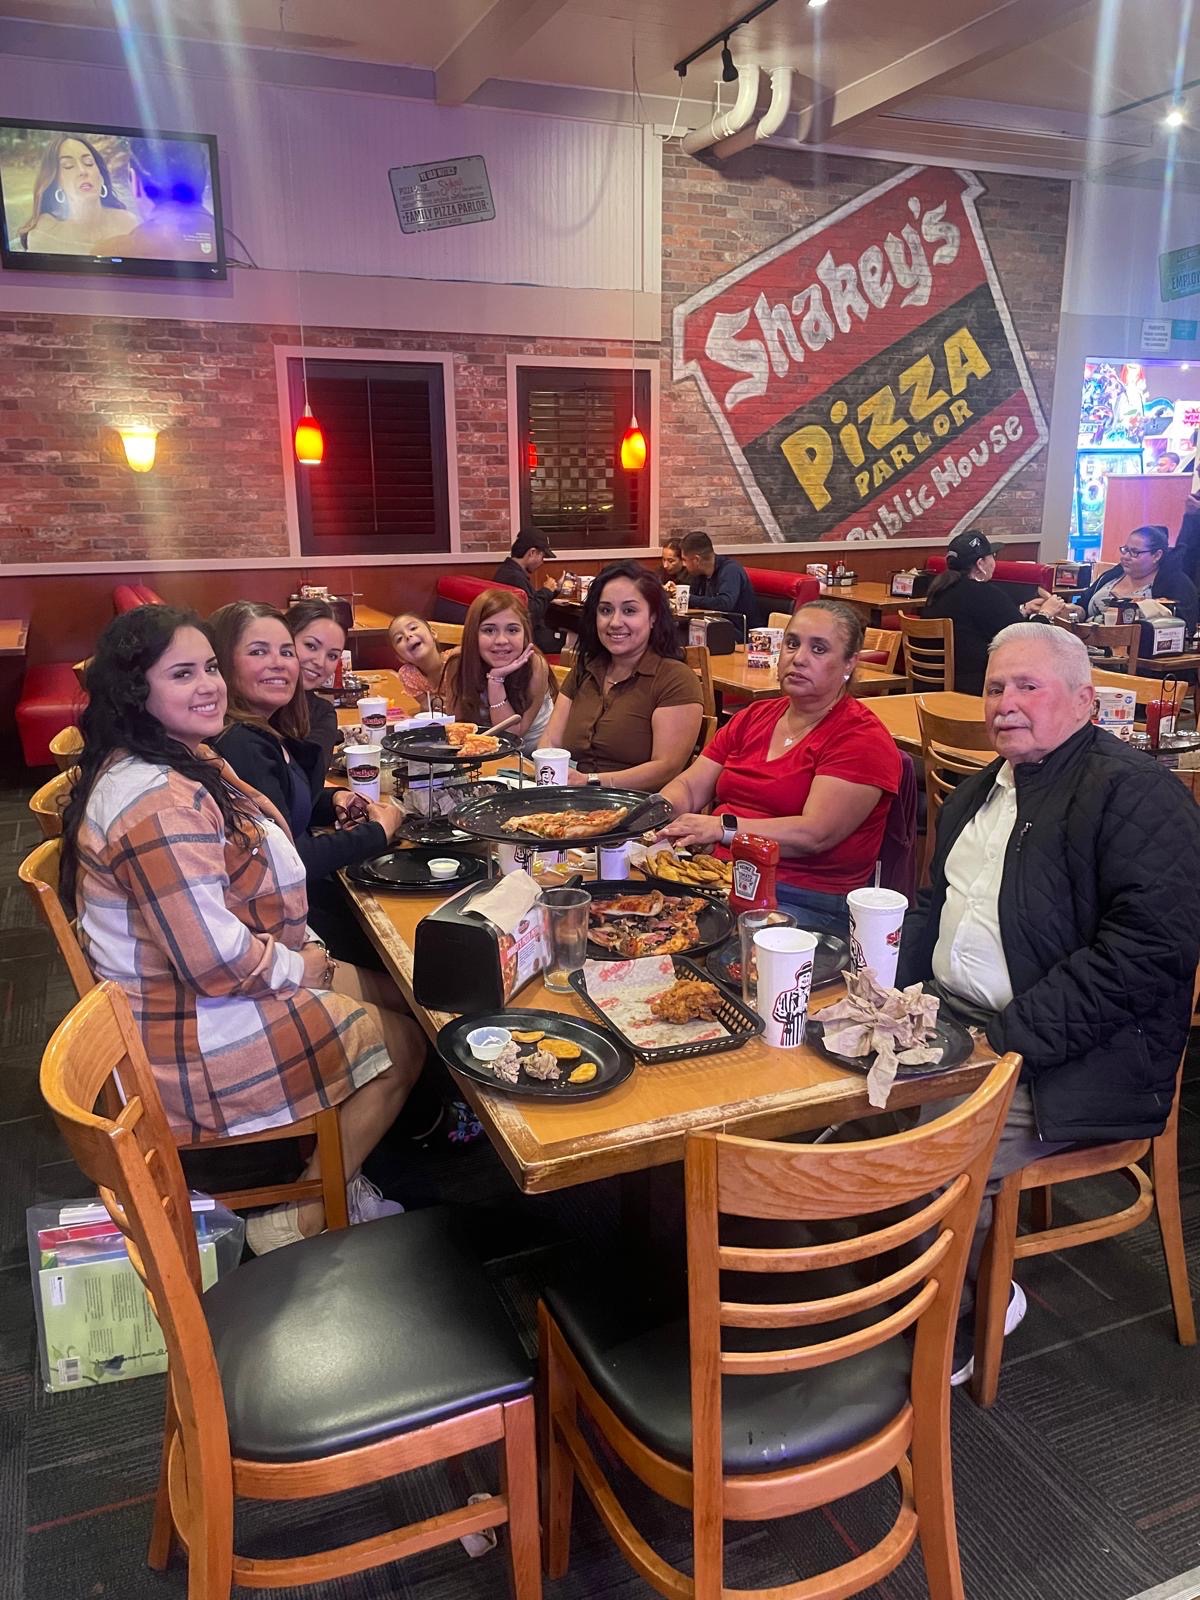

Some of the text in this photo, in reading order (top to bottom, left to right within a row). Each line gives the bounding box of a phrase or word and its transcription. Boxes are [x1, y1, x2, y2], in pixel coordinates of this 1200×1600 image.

[404, 209, 434, 222] FAMILY
[433, 204, 458, 218] PIZZA
[457, 200, 487, 214] PARLOR
[705, 196, 961, 411] Shakey's
[855, 399, 974, 497] PARLOR
[930, 415, 1024, 498] House
